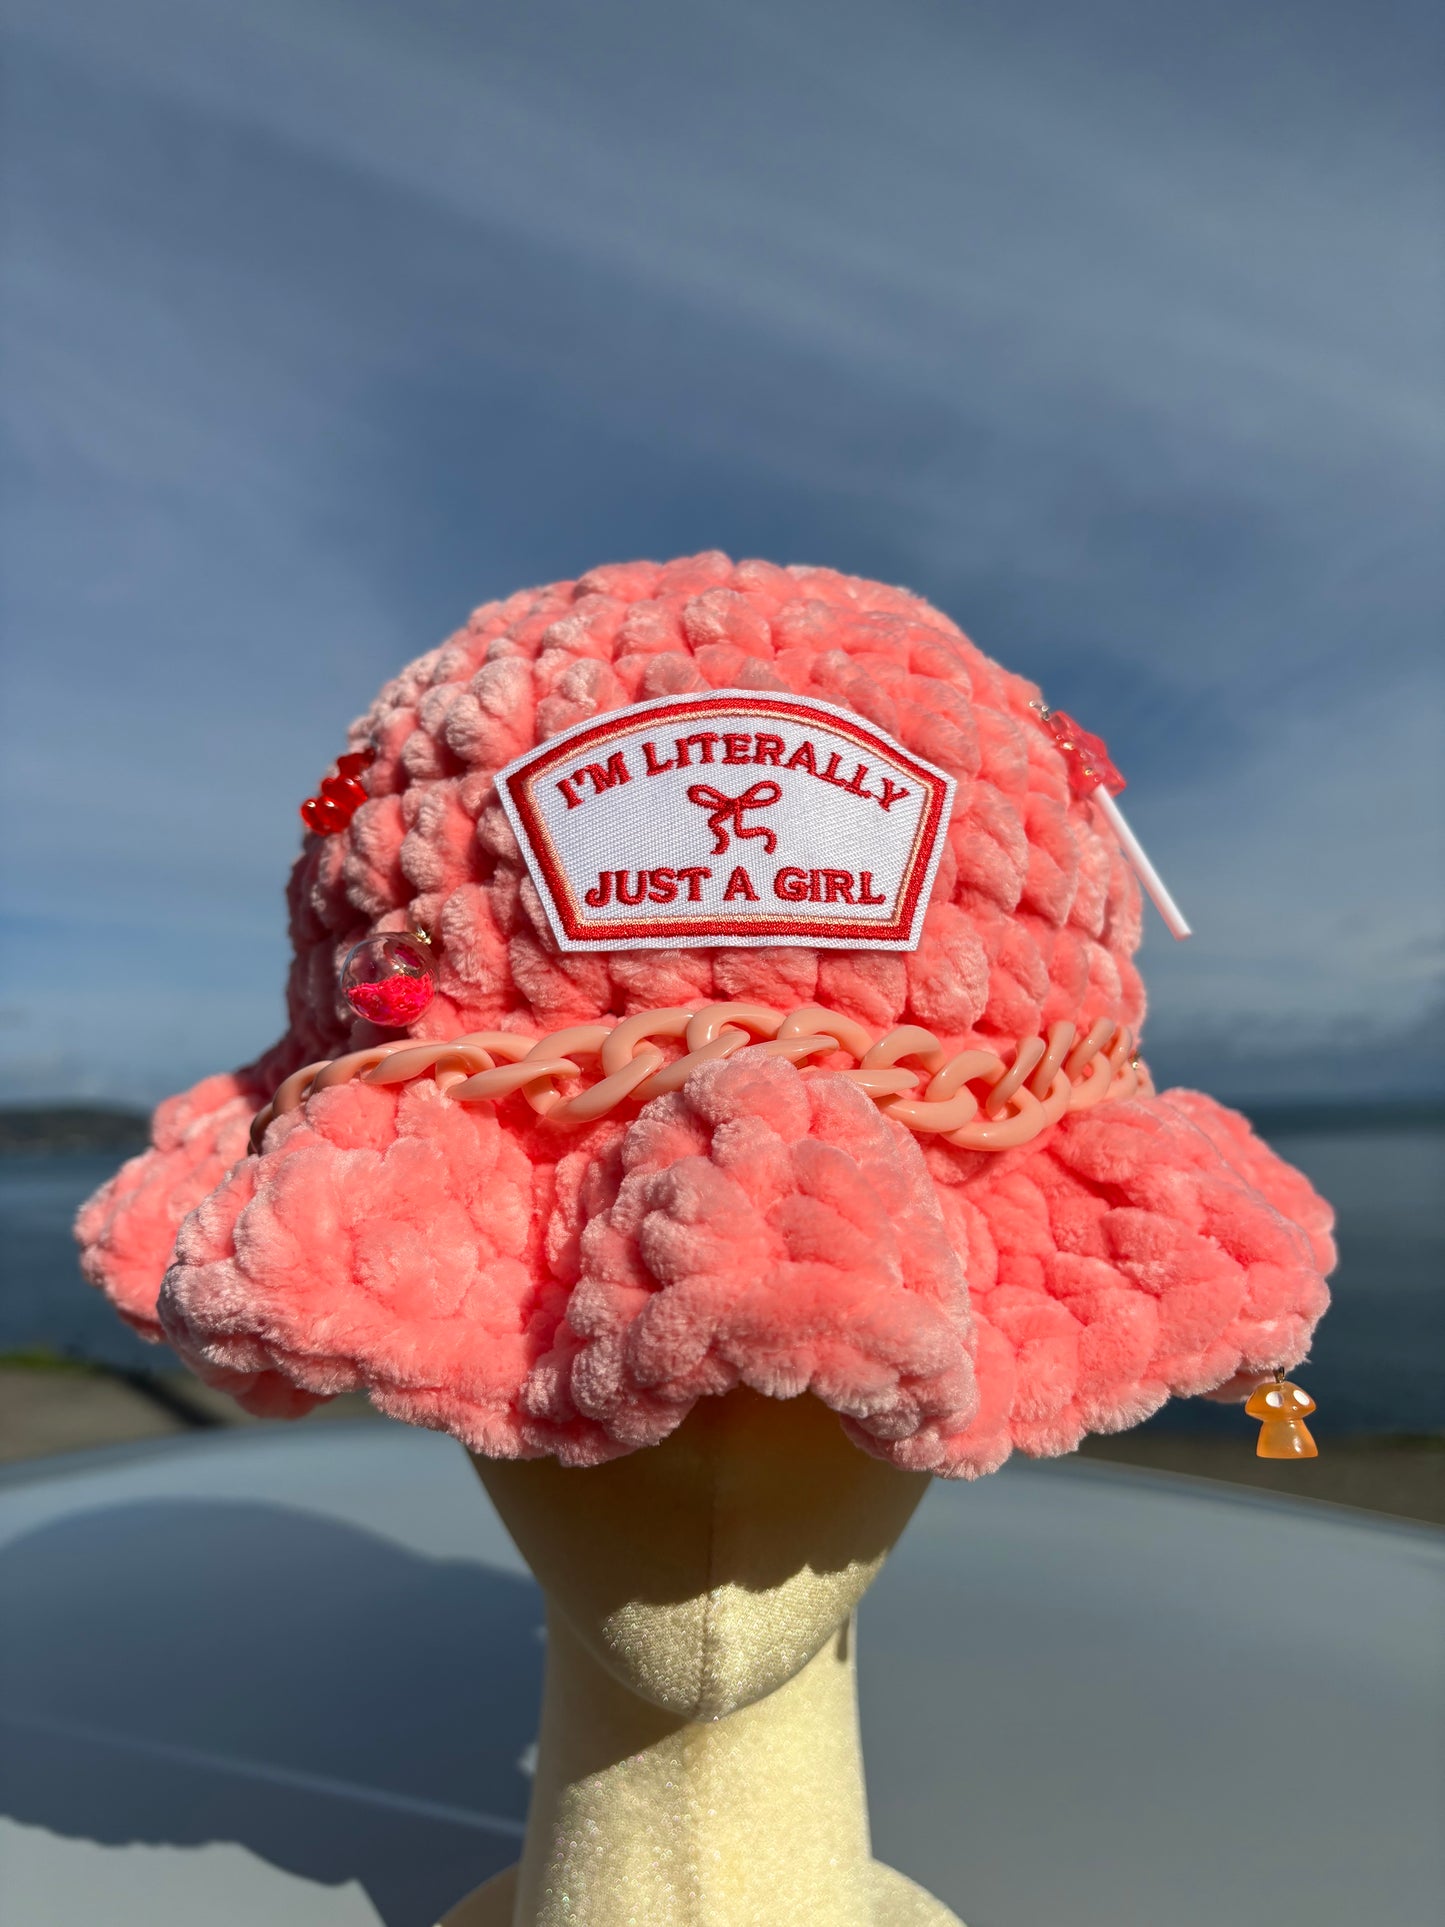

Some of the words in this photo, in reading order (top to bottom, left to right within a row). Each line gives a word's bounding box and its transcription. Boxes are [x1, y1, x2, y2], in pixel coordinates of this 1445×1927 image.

[555, 751, 632, 809] I'M
[642, 732, 910, 812] LITERALLY
[584, 866, 712, 908] JUST
[723, 866, 760, 902] A
[773, 866, 886, 905] GIRL
